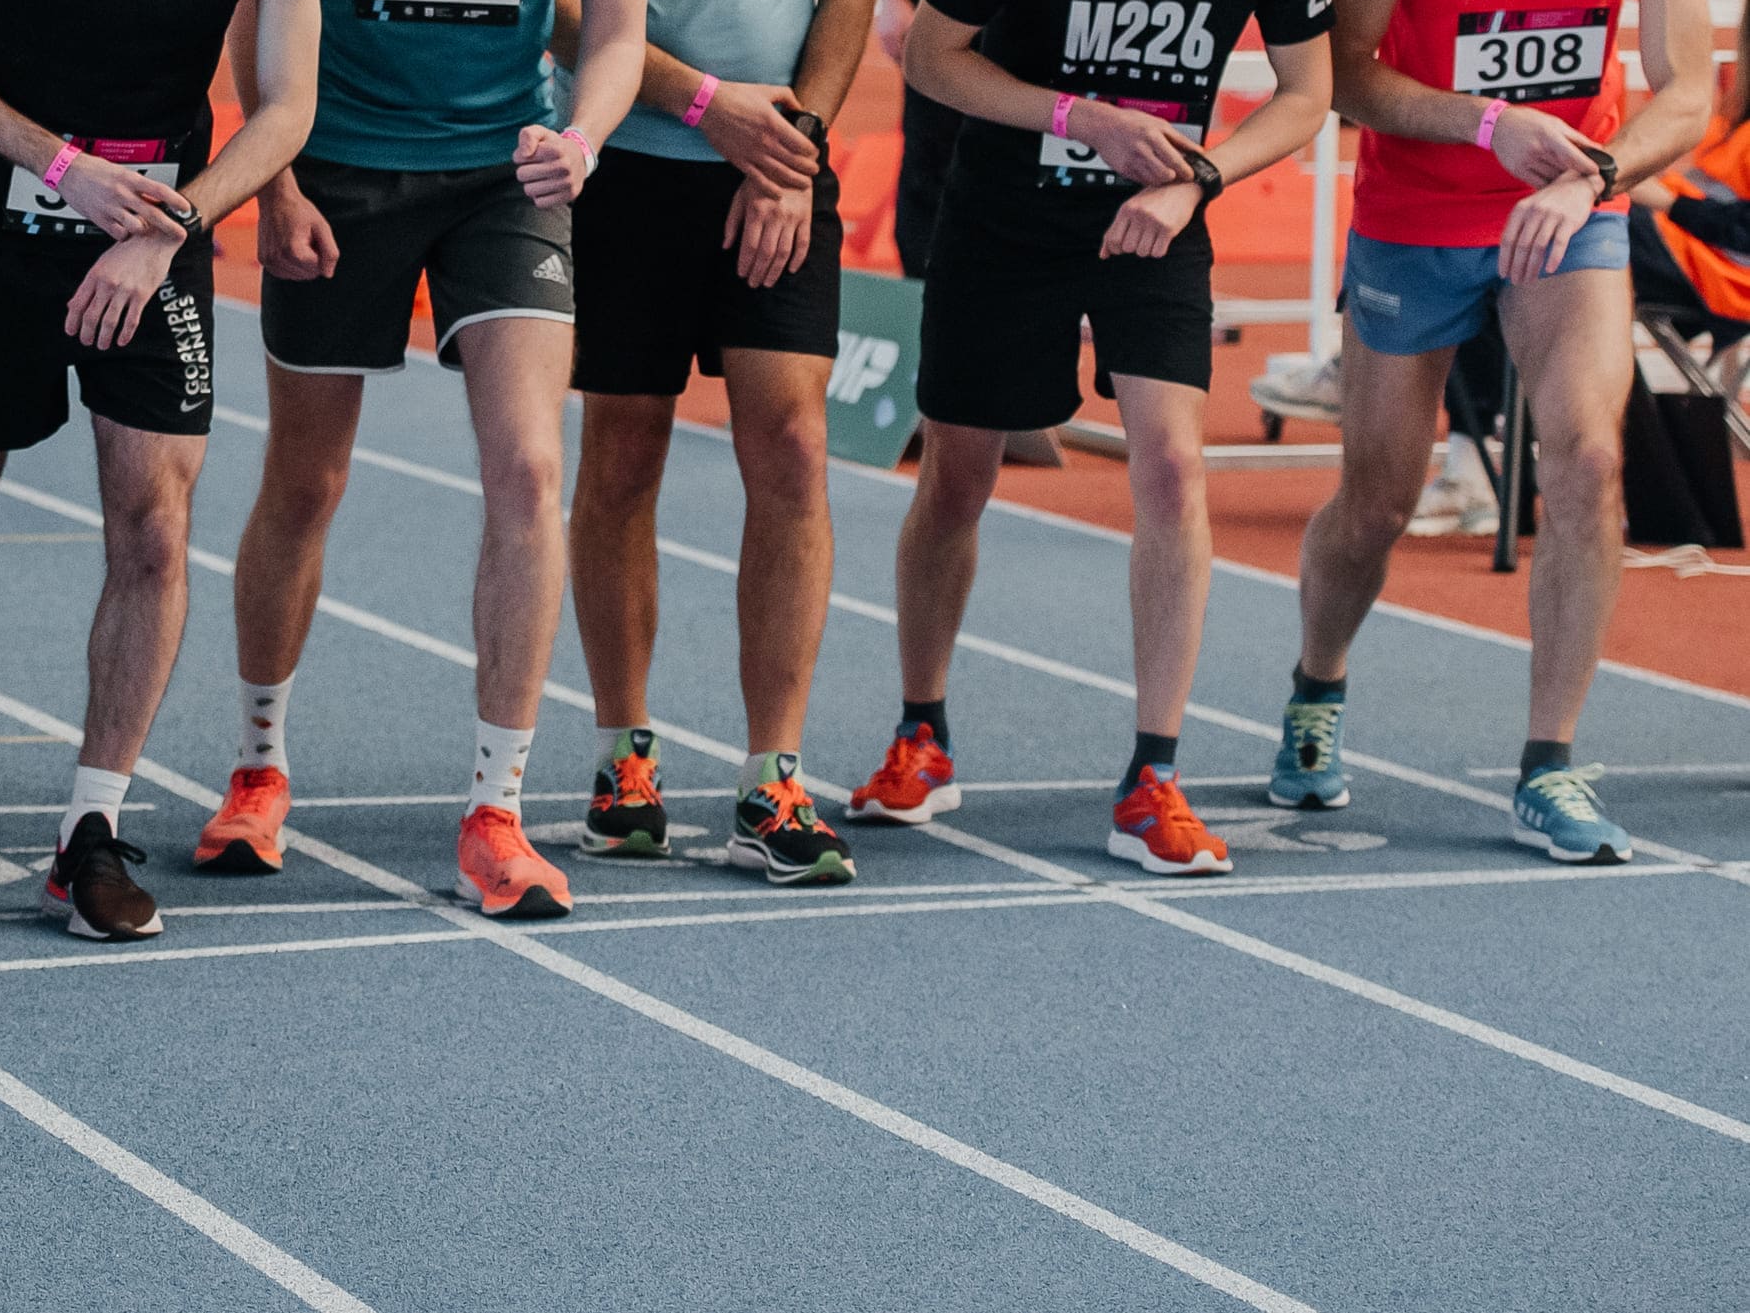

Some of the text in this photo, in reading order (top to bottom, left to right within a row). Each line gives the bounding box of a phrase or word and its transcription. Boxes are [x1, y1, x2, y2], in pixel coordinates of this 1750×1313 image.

[1064, 0, 1216, 70] M226
[1478, 32, 1583, 82] 308
[179, 294, 211, 394] RUNNERS
